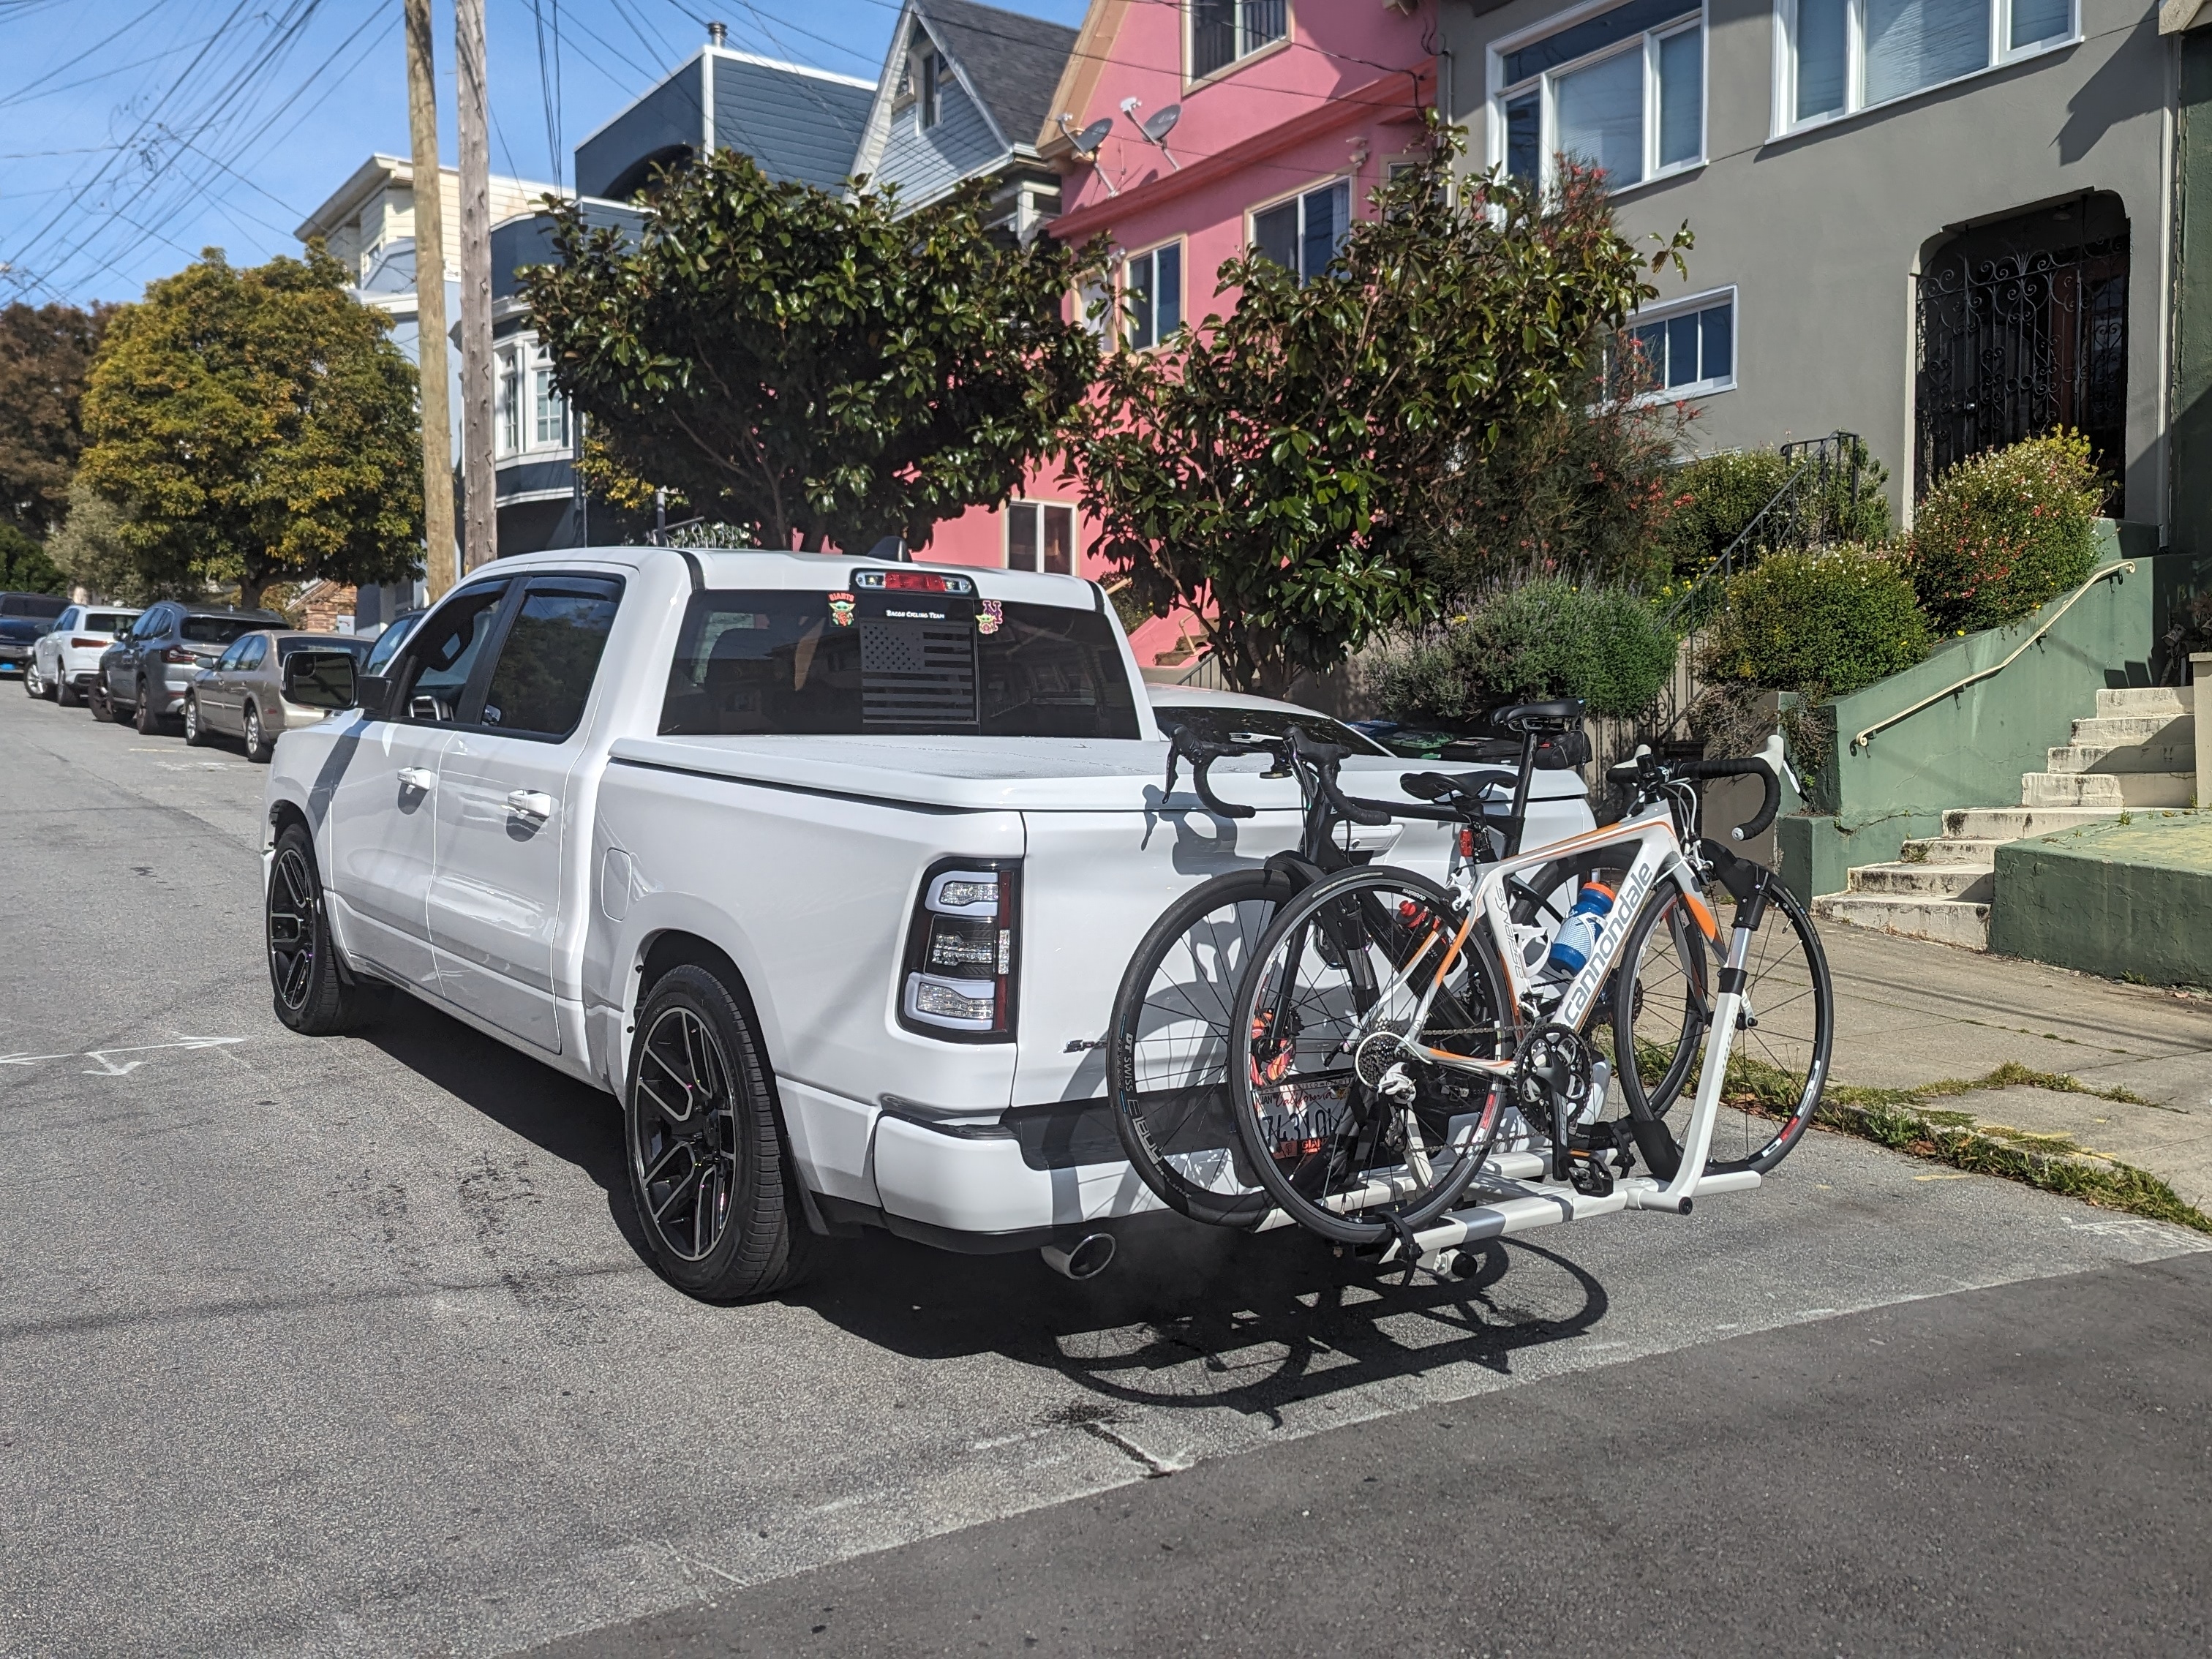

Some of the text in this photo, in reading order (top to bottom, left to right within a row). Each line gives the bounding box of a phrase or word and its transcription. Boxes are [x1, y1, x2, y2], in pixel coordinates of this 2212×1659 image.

[829, 592, 854, 602] GIANTS
[1564, 862, 1653, 1025] cannondale
[1124, 1032, 1133, 1091] DT SWISS
